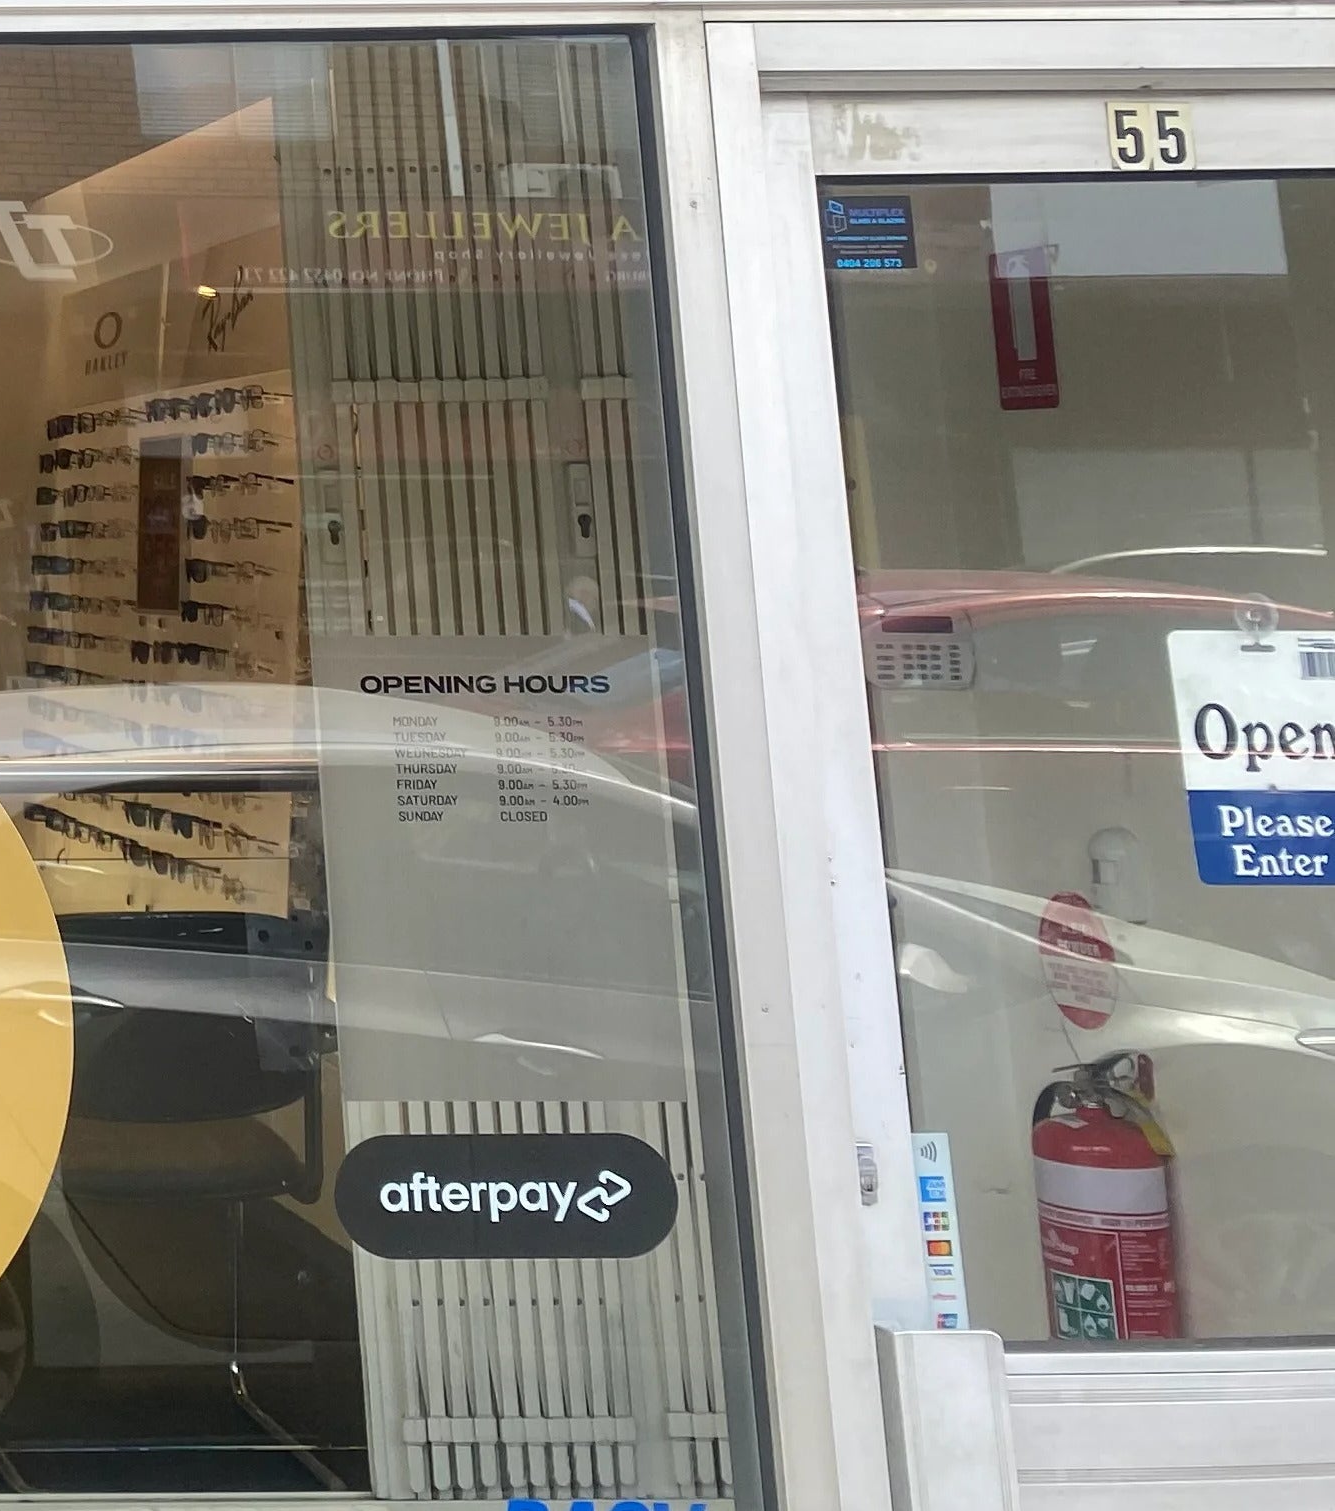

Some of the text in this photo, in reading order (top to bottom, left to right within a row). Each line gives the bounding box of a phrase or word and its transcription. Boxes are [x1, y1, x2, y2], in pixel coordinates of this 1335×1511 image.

[1114, 109, 1188, 166] 55
[359, 675, 611, 695] OPENING HOURS
[392, 716, 439, 728] MONDAY
[393, 732, 447, 744] TUESDAY
[394, 748, 467, 760] WEDNESDAY
[395, 764, 458, 776] THURSDAY
[395, 779, 438, 791] FRIDAY
[397, 795, 458, 807] SATURDAY
[398, 811, 548, 823] SUNDAY CLOSED
[1217, 803, 1335, 839] Please
[1232, 844, 1330, 879] Enter
[379, 1171, 579, 1223] afterpay
